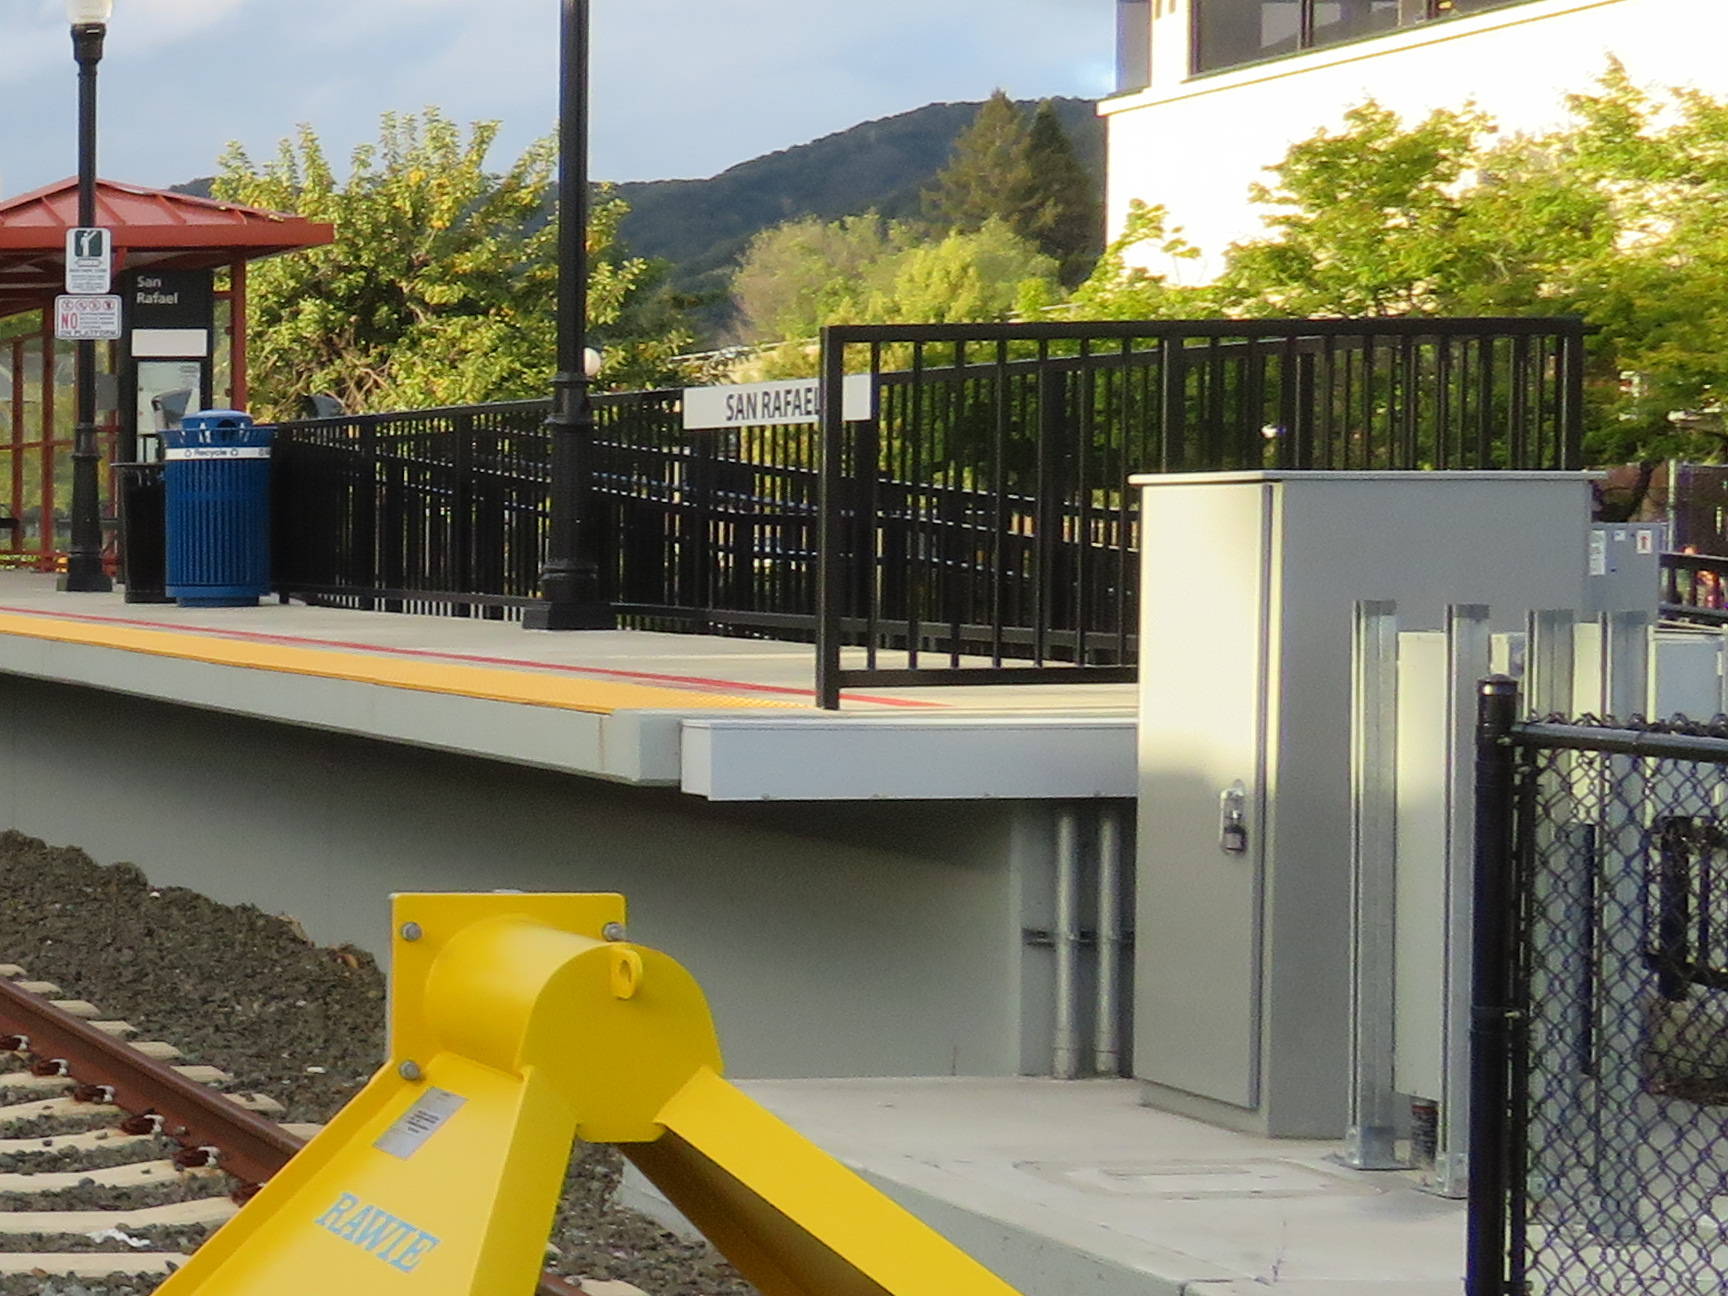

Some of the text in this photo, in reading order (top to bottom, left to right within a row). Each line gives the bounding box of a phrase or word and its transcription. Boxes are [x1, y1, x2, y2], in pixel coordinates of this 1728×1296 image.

[137, 275, 162, 287] San
[136, 291, 179, 304] Rafael
[61, 312, 78, 329] NO
[726, 387, 820, 421] SAN RAFAEL
[314, 1191, 441, 1274] RAWIE
